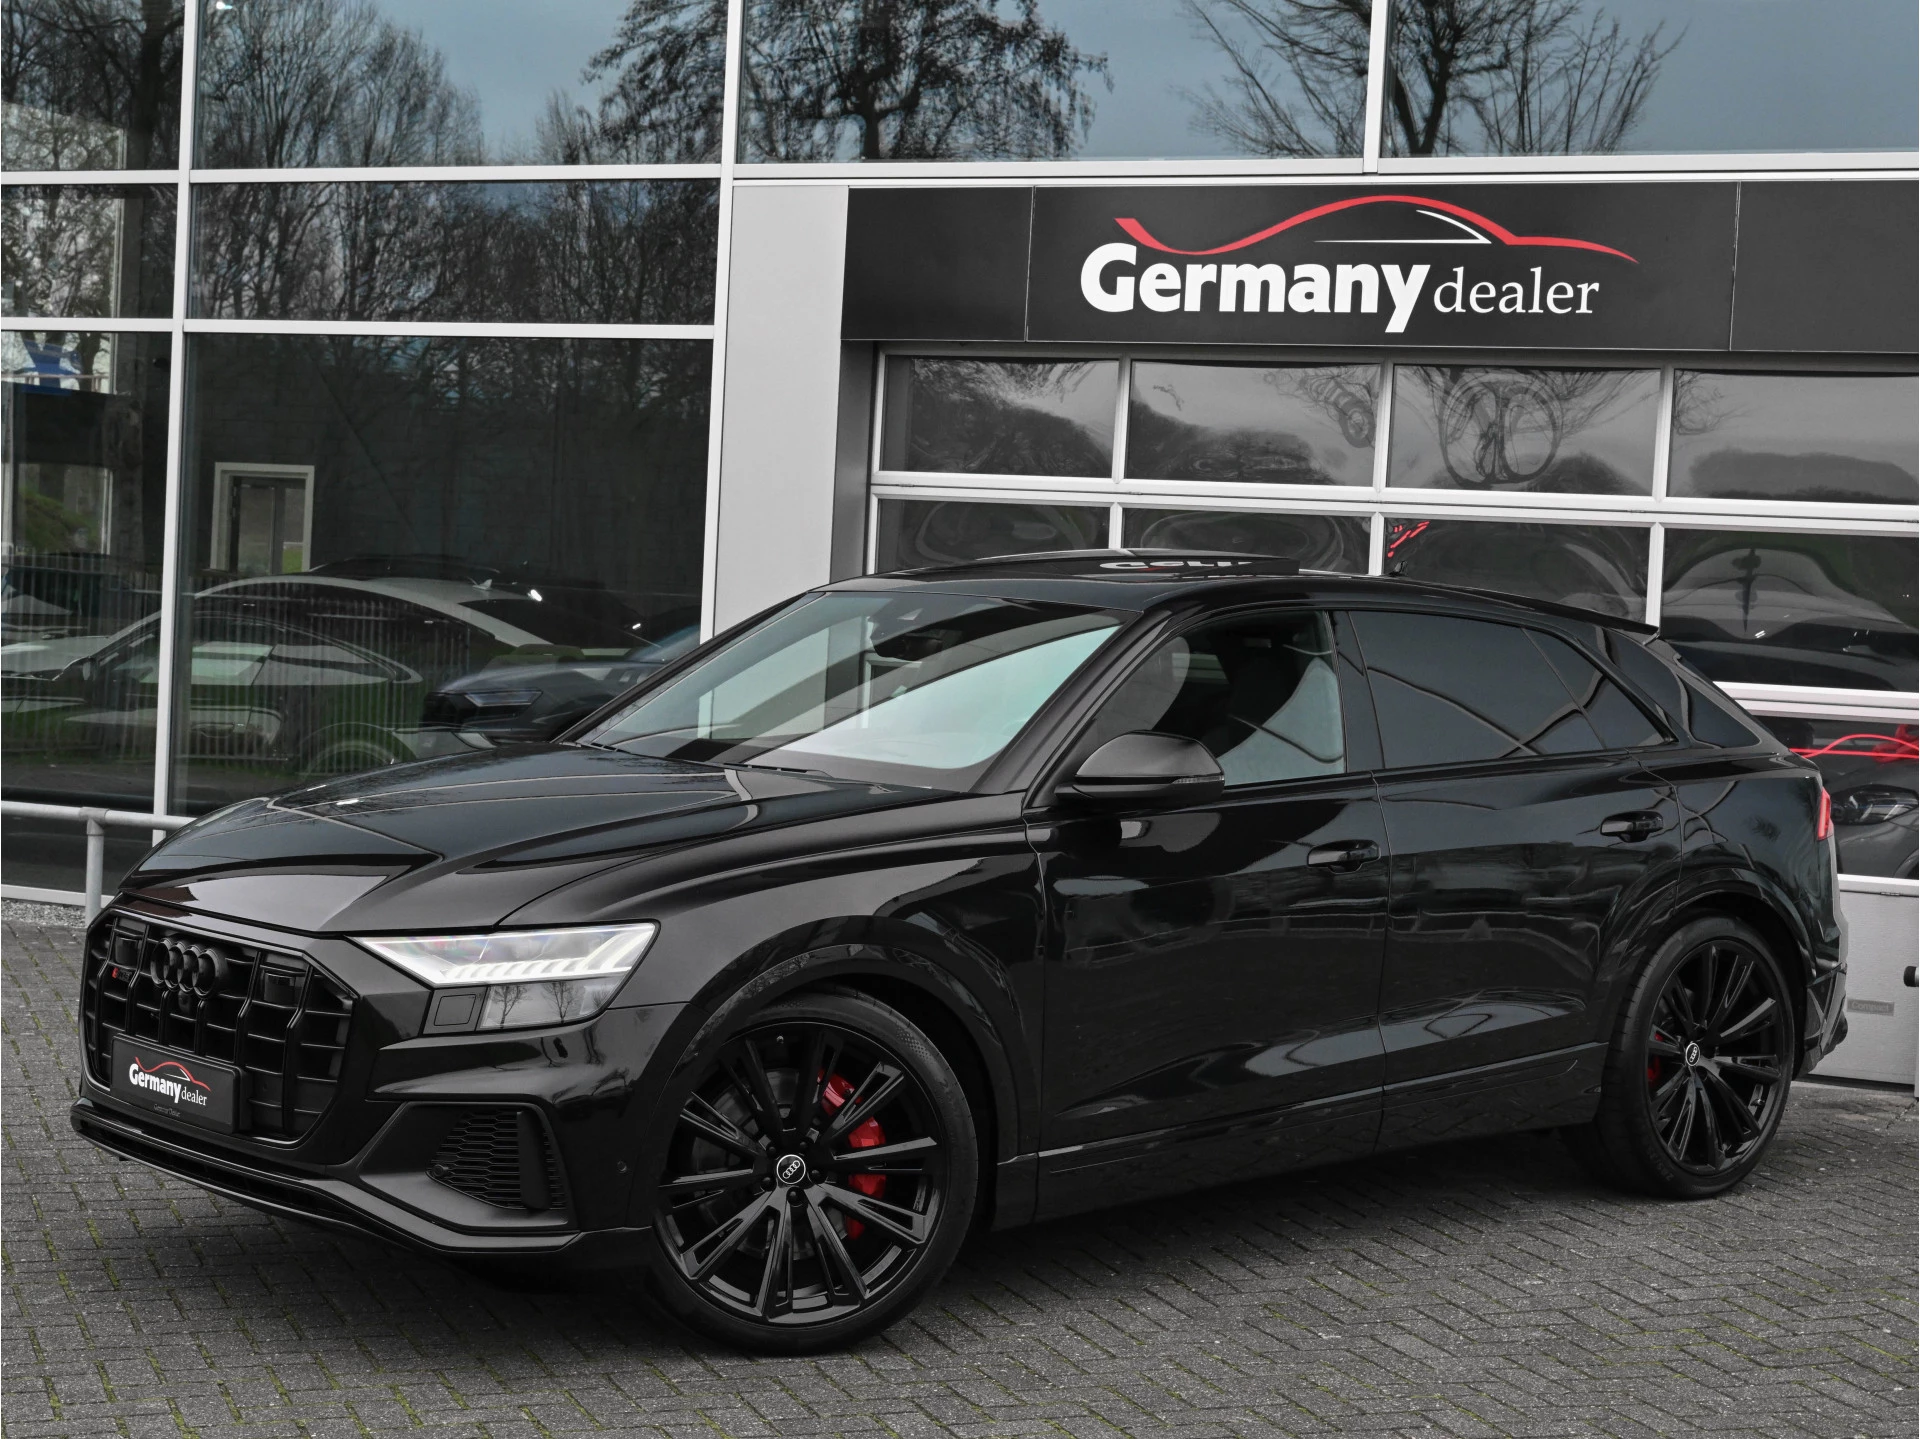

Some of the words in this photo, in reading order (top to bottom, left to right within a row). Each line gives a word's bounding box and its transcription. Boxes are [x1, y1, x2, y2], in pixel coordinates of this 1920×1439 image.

[1080, 242, 1431, 333] Germany
[1433, 266, 1600, 314] dealer
[129, 1063, 182, 1103] Germany
[181, 1086, 207, 1106] dealer
